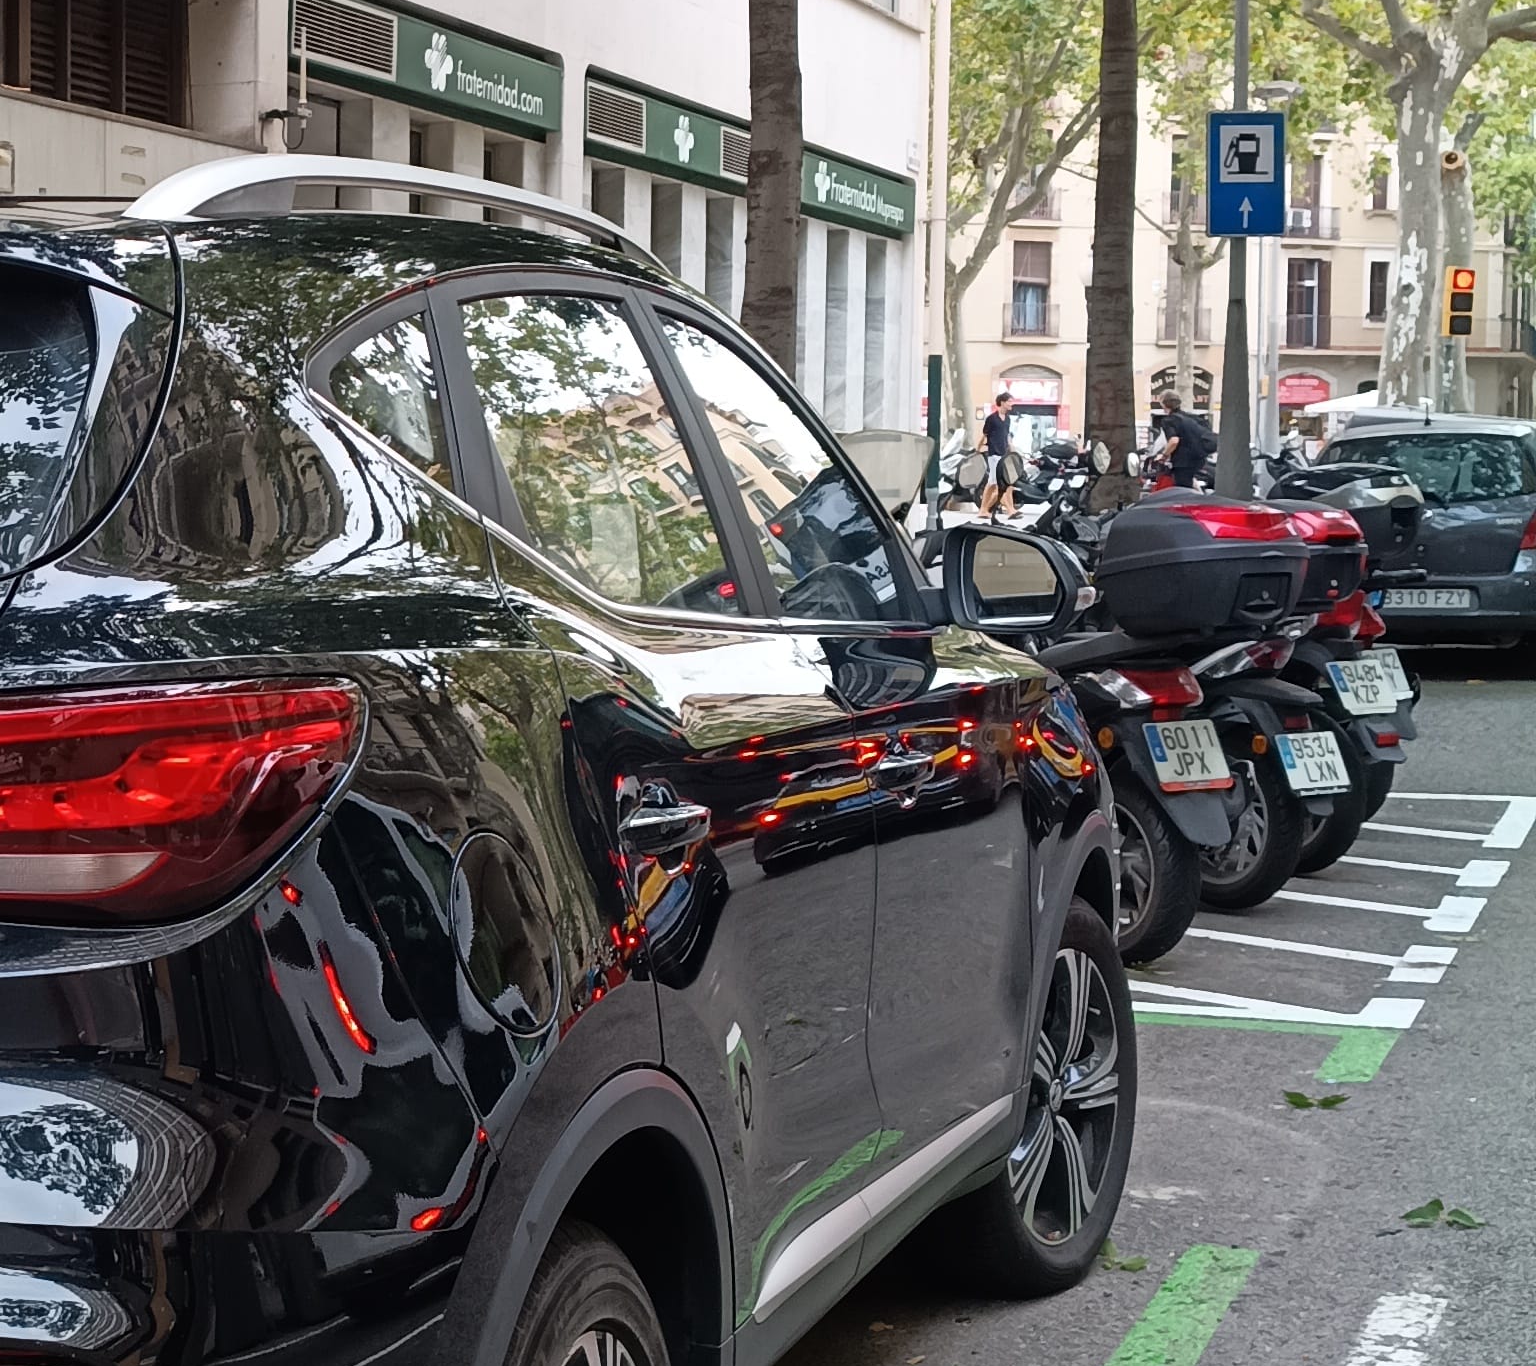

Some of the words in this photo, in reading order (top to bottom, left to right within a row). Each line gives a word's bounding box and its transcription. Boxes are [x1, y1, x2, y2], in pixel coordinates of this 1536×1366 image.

[457, 59, 543, 116] fraternidad.com
[830, 172, 877, 214] Fraternidad
[1434, 589, 1466, 605] FZY
[1342, 663, 1383, 684] 9484
[1350, 684, 1380, 704] KZP
[1161, 724, 1214, 750] 6011
[1292, 736, 1336, 760] 9534
[1174, 751, 1212, 776] JPX
[1304, 761, 1340, 783] LXN
